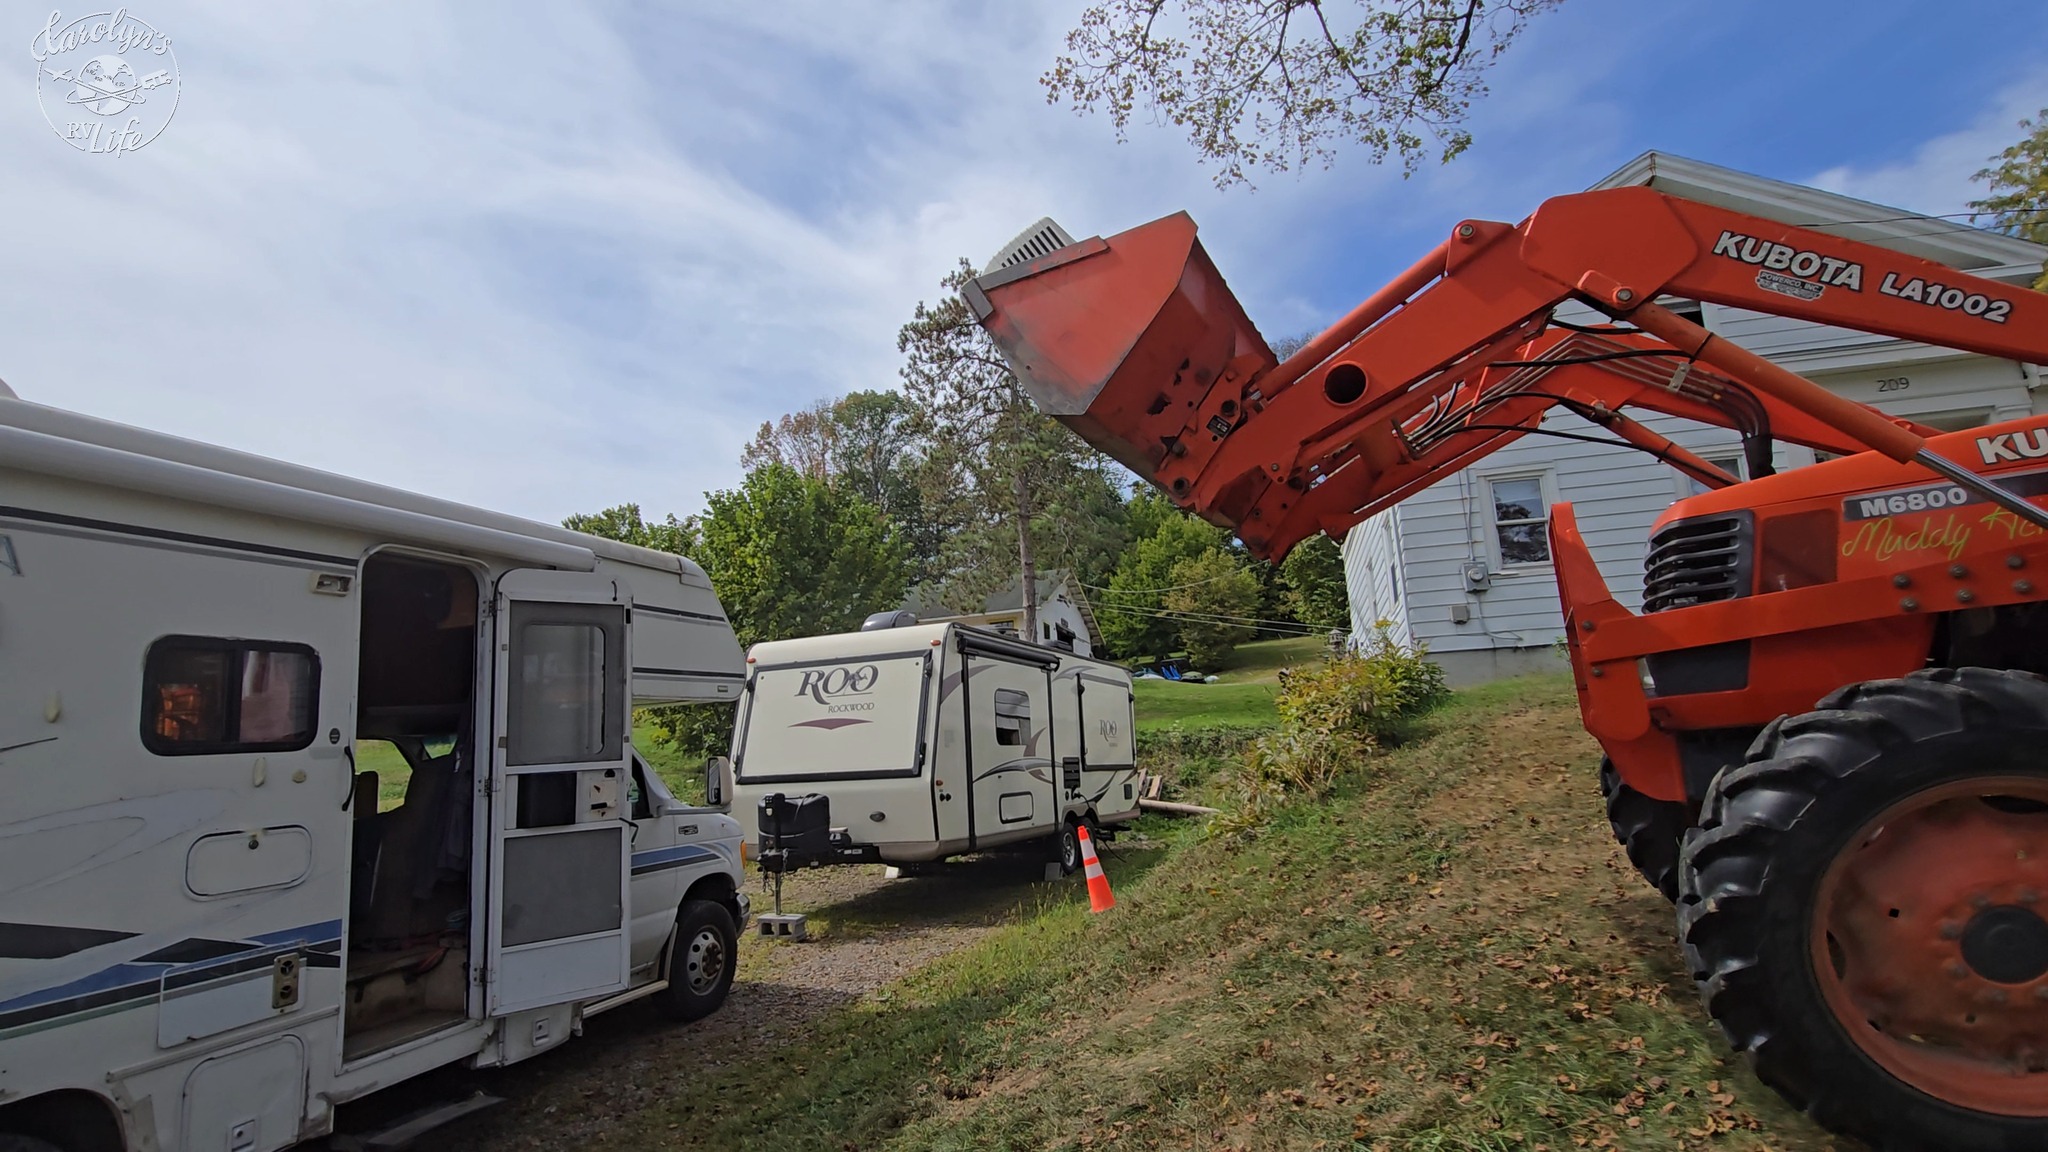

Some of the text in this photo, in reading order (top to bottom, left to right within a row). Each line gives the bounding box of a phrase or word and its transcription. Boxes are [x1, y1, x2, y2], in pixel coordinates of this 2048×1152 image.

[1712, 230, 2012, 323] KUBOTA LA1002
[1876, 377, 1911, 392] 209
[1860, 486, 1968, 518] M6800
[1842, 513, 1971, 562] Muddy
[794, 665, 879, 706] ROO
[828, 702, 875, 713] ROCKWOOD
[1098, 719, 1118, 742] ROO
